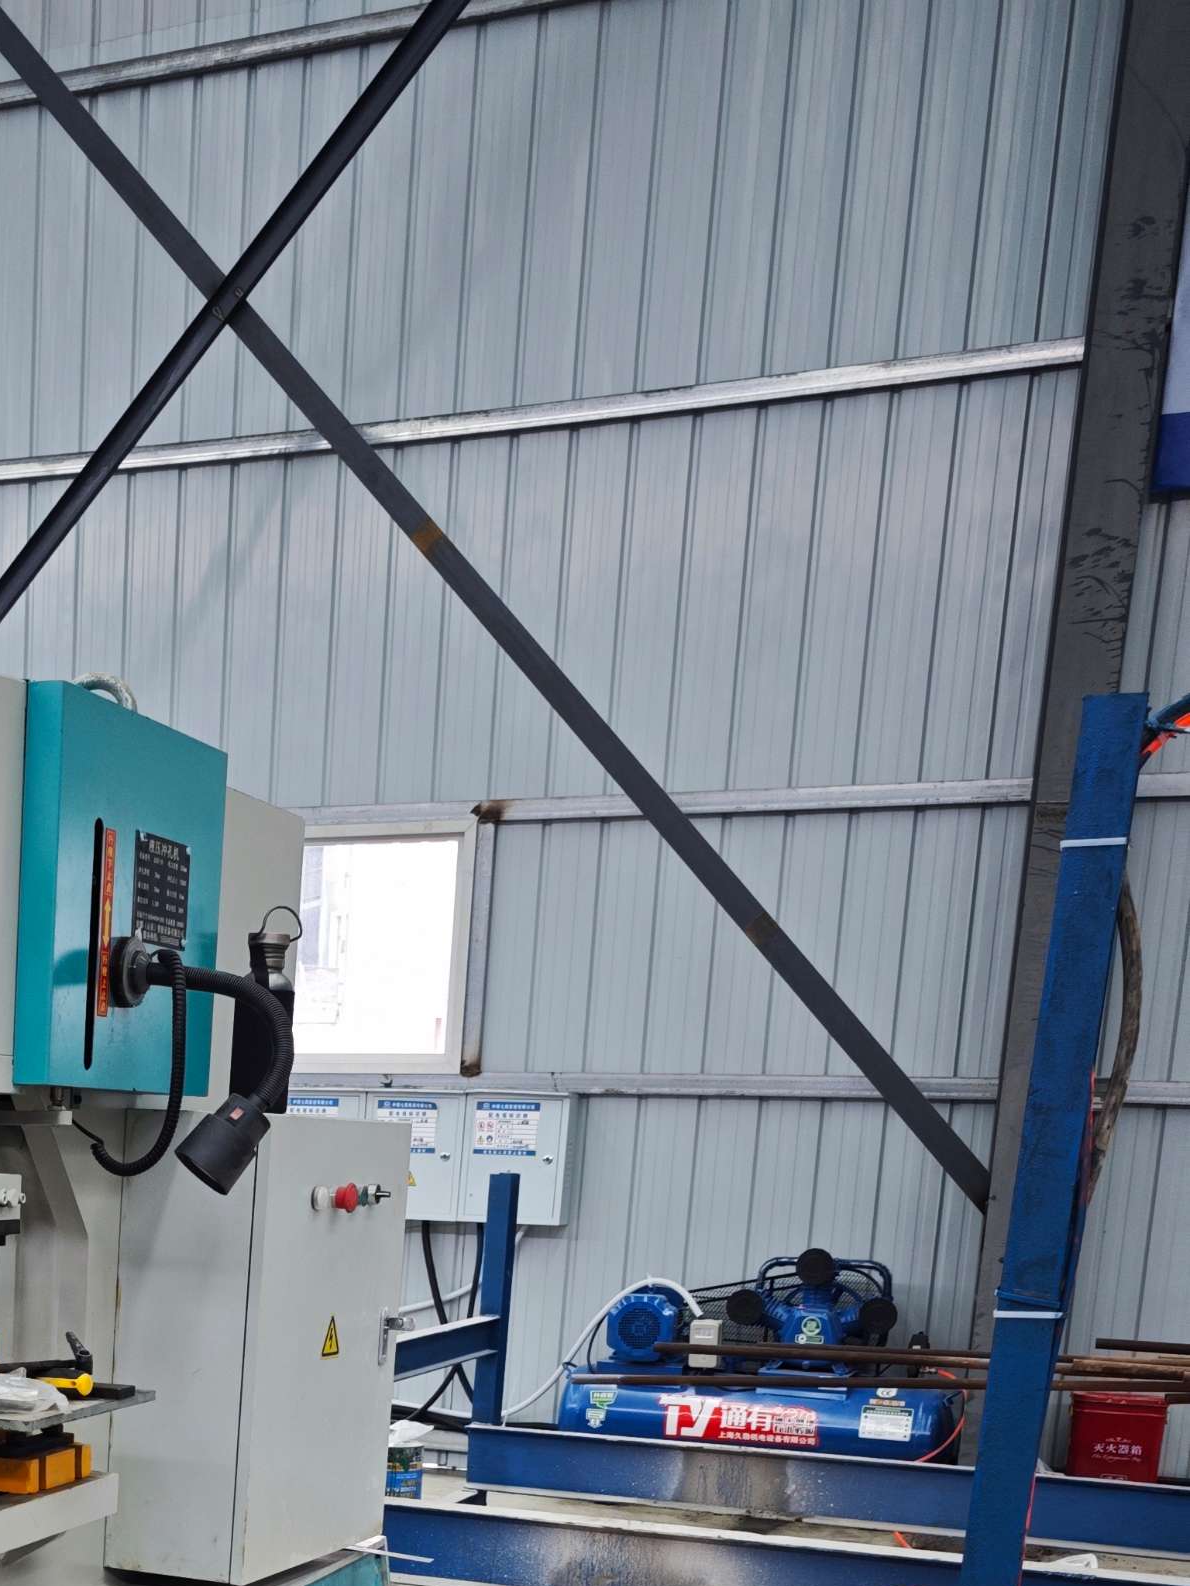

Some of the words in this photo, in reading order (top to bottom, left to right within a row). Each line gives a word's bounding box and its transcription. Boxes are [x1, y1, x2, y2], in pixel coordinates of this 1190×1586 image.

[721, 1403, 772, 1431] 通有
[1093, 1443, 1143, 1456] 灭火器箱
